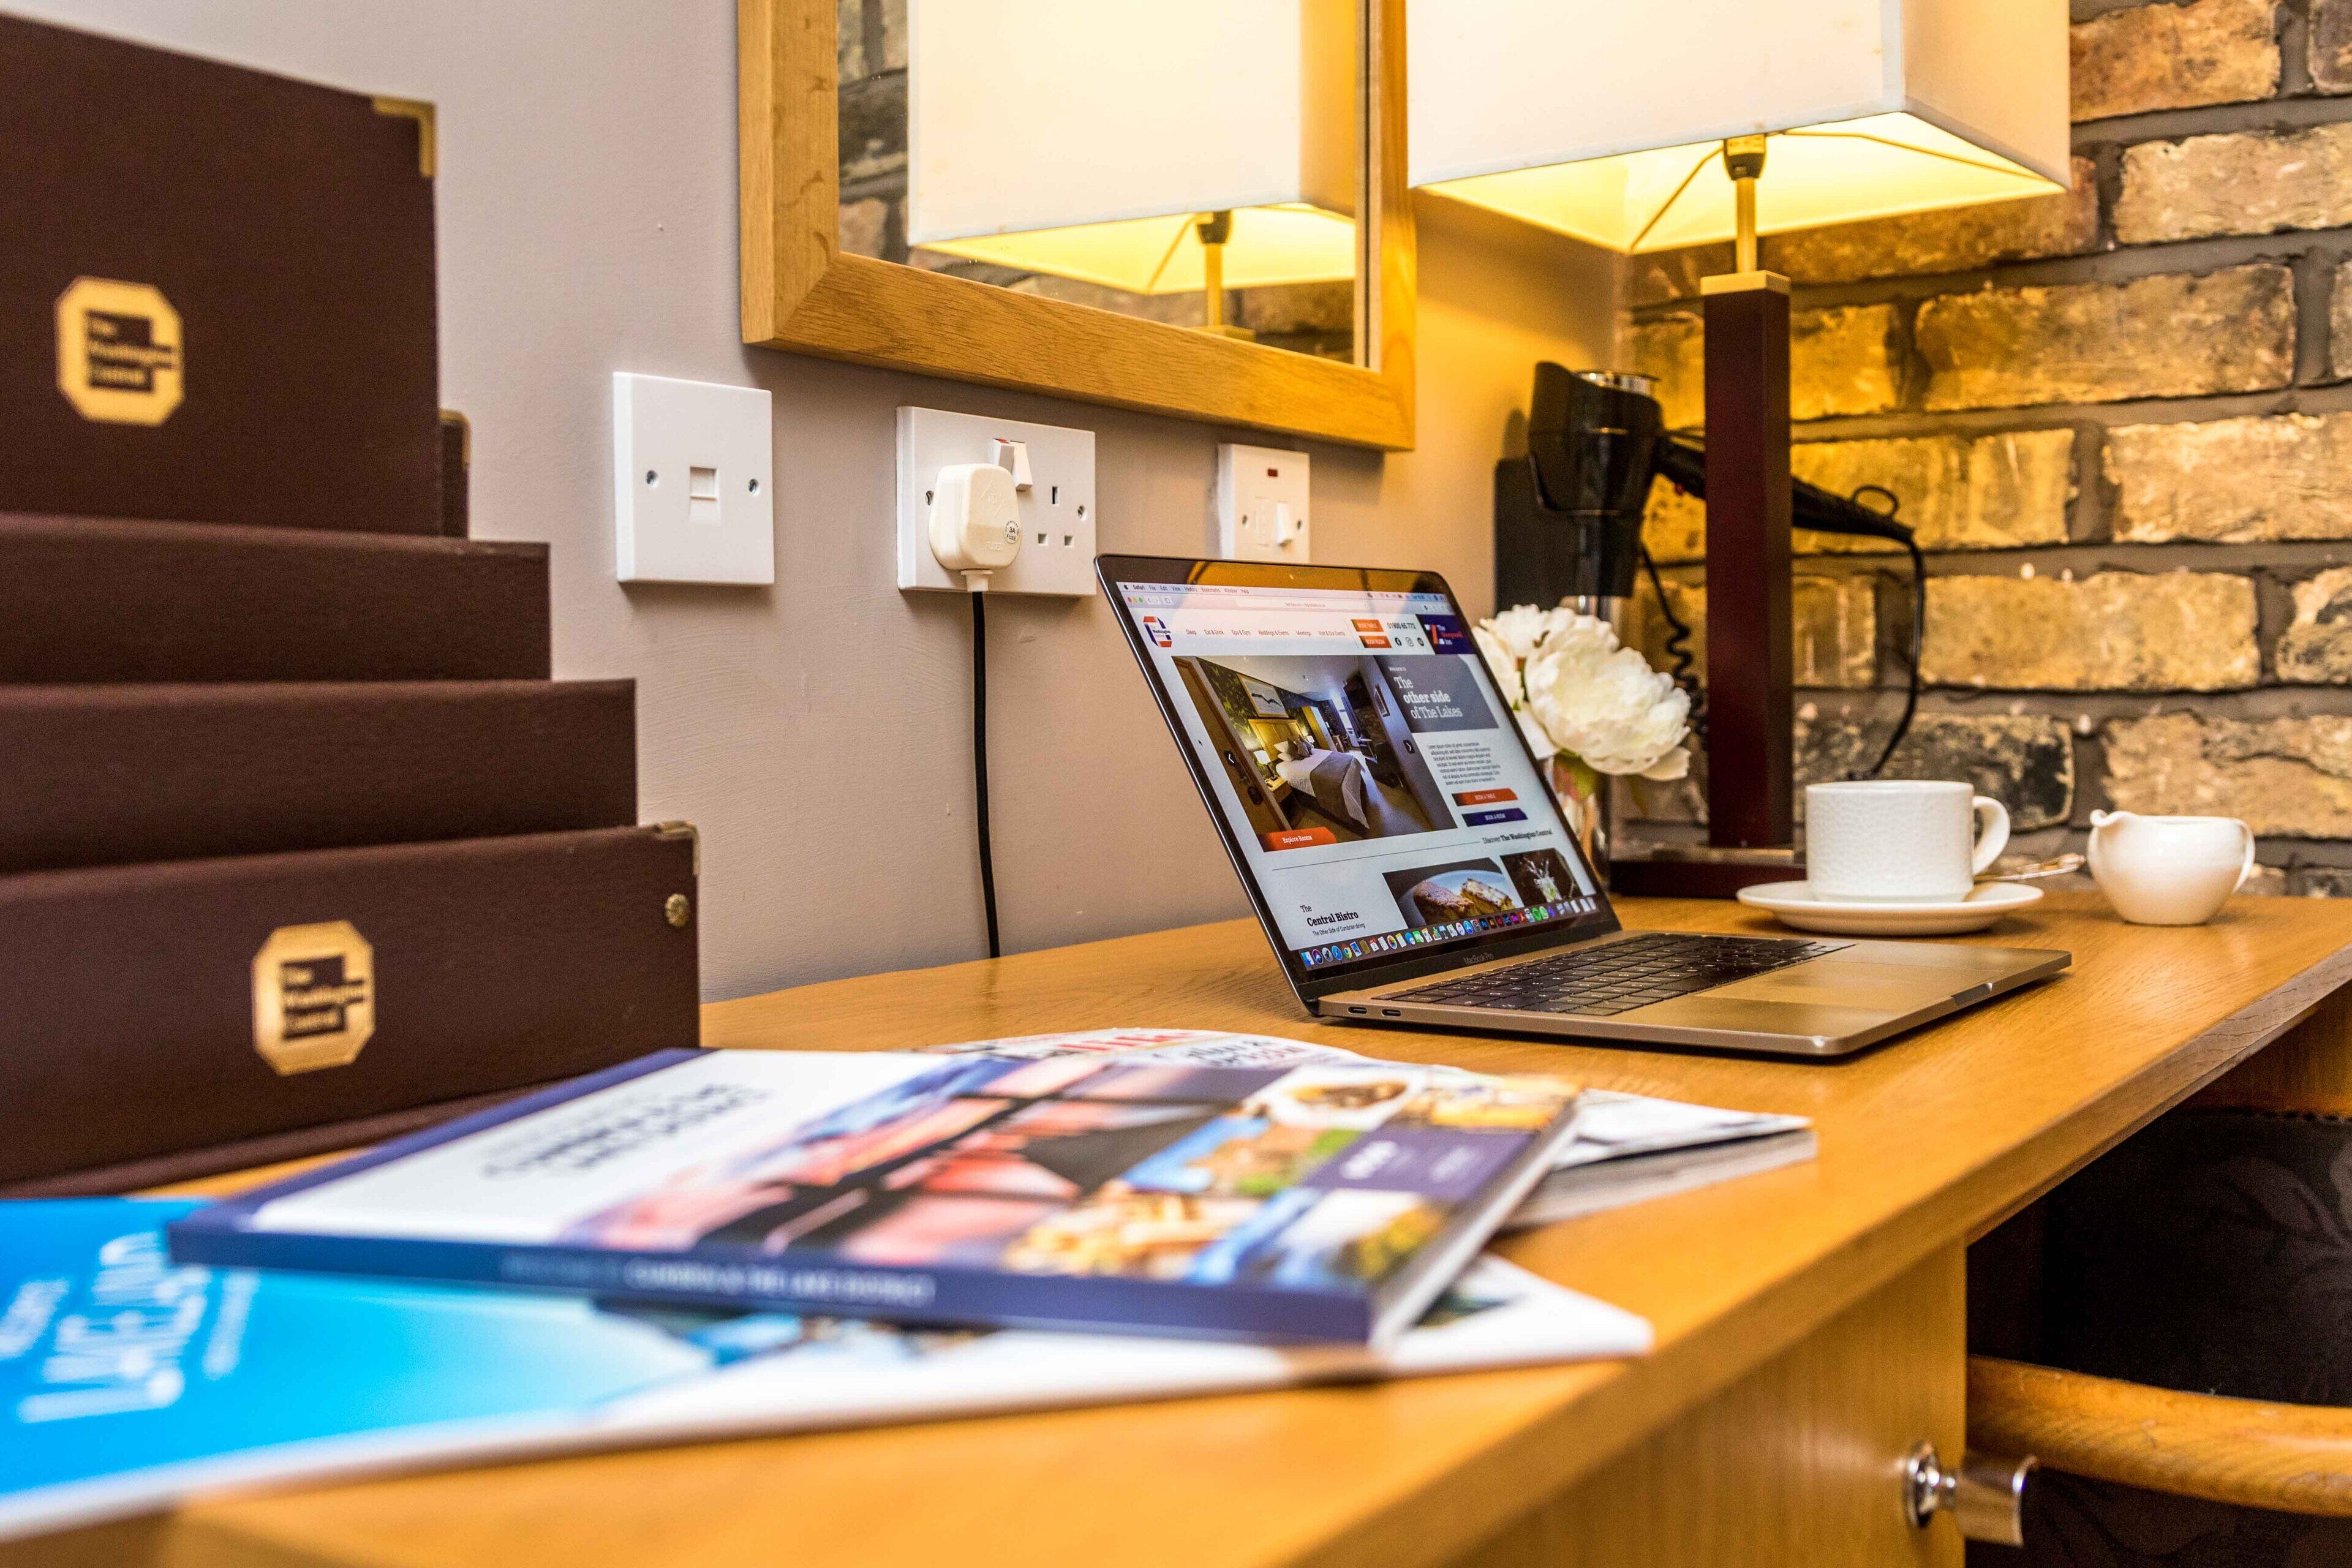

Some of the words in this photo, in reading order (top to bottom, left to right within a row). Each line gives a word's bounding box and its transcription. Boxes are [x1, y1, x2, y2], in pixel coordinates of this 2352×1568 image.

[1393, 676, 1414, 688] The
[1403, 691, 1430, 704] other
[1430, 690, 1451, 703] side
[1411, 706, 1420, 718] of
[1418, 706, 1438, 718] The
[1436, 705, 1463, 718] Lakes
[1282, 836, 1298, 845] Explore
[1306, 913, 1336, 927] Central
[1334, 911, 1359, 922] Bistro
